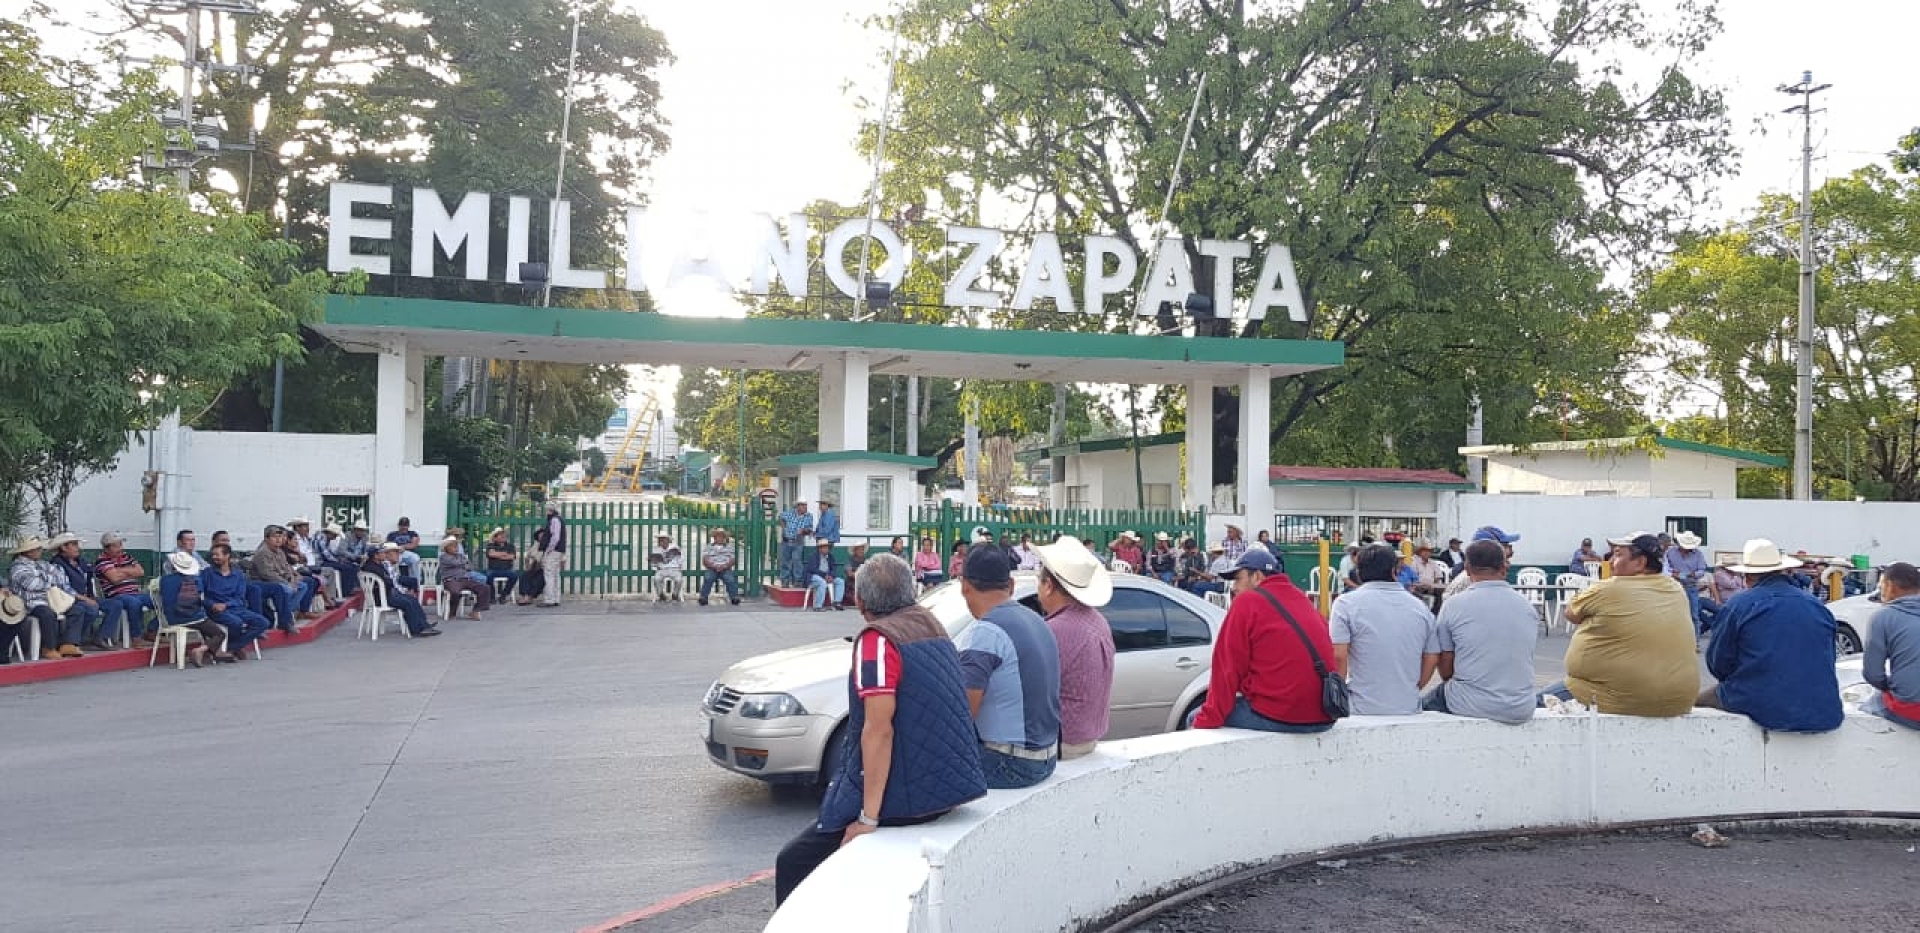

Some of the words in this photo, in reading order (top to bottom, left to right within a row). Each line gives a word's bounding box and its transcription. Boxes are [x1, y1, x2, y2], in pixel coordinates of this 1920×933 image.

[327, 182, 905, 300] EMILIANO
[944, 224, 1309, 322] ZAPATA
[324, 506, 365, 524] BSM
